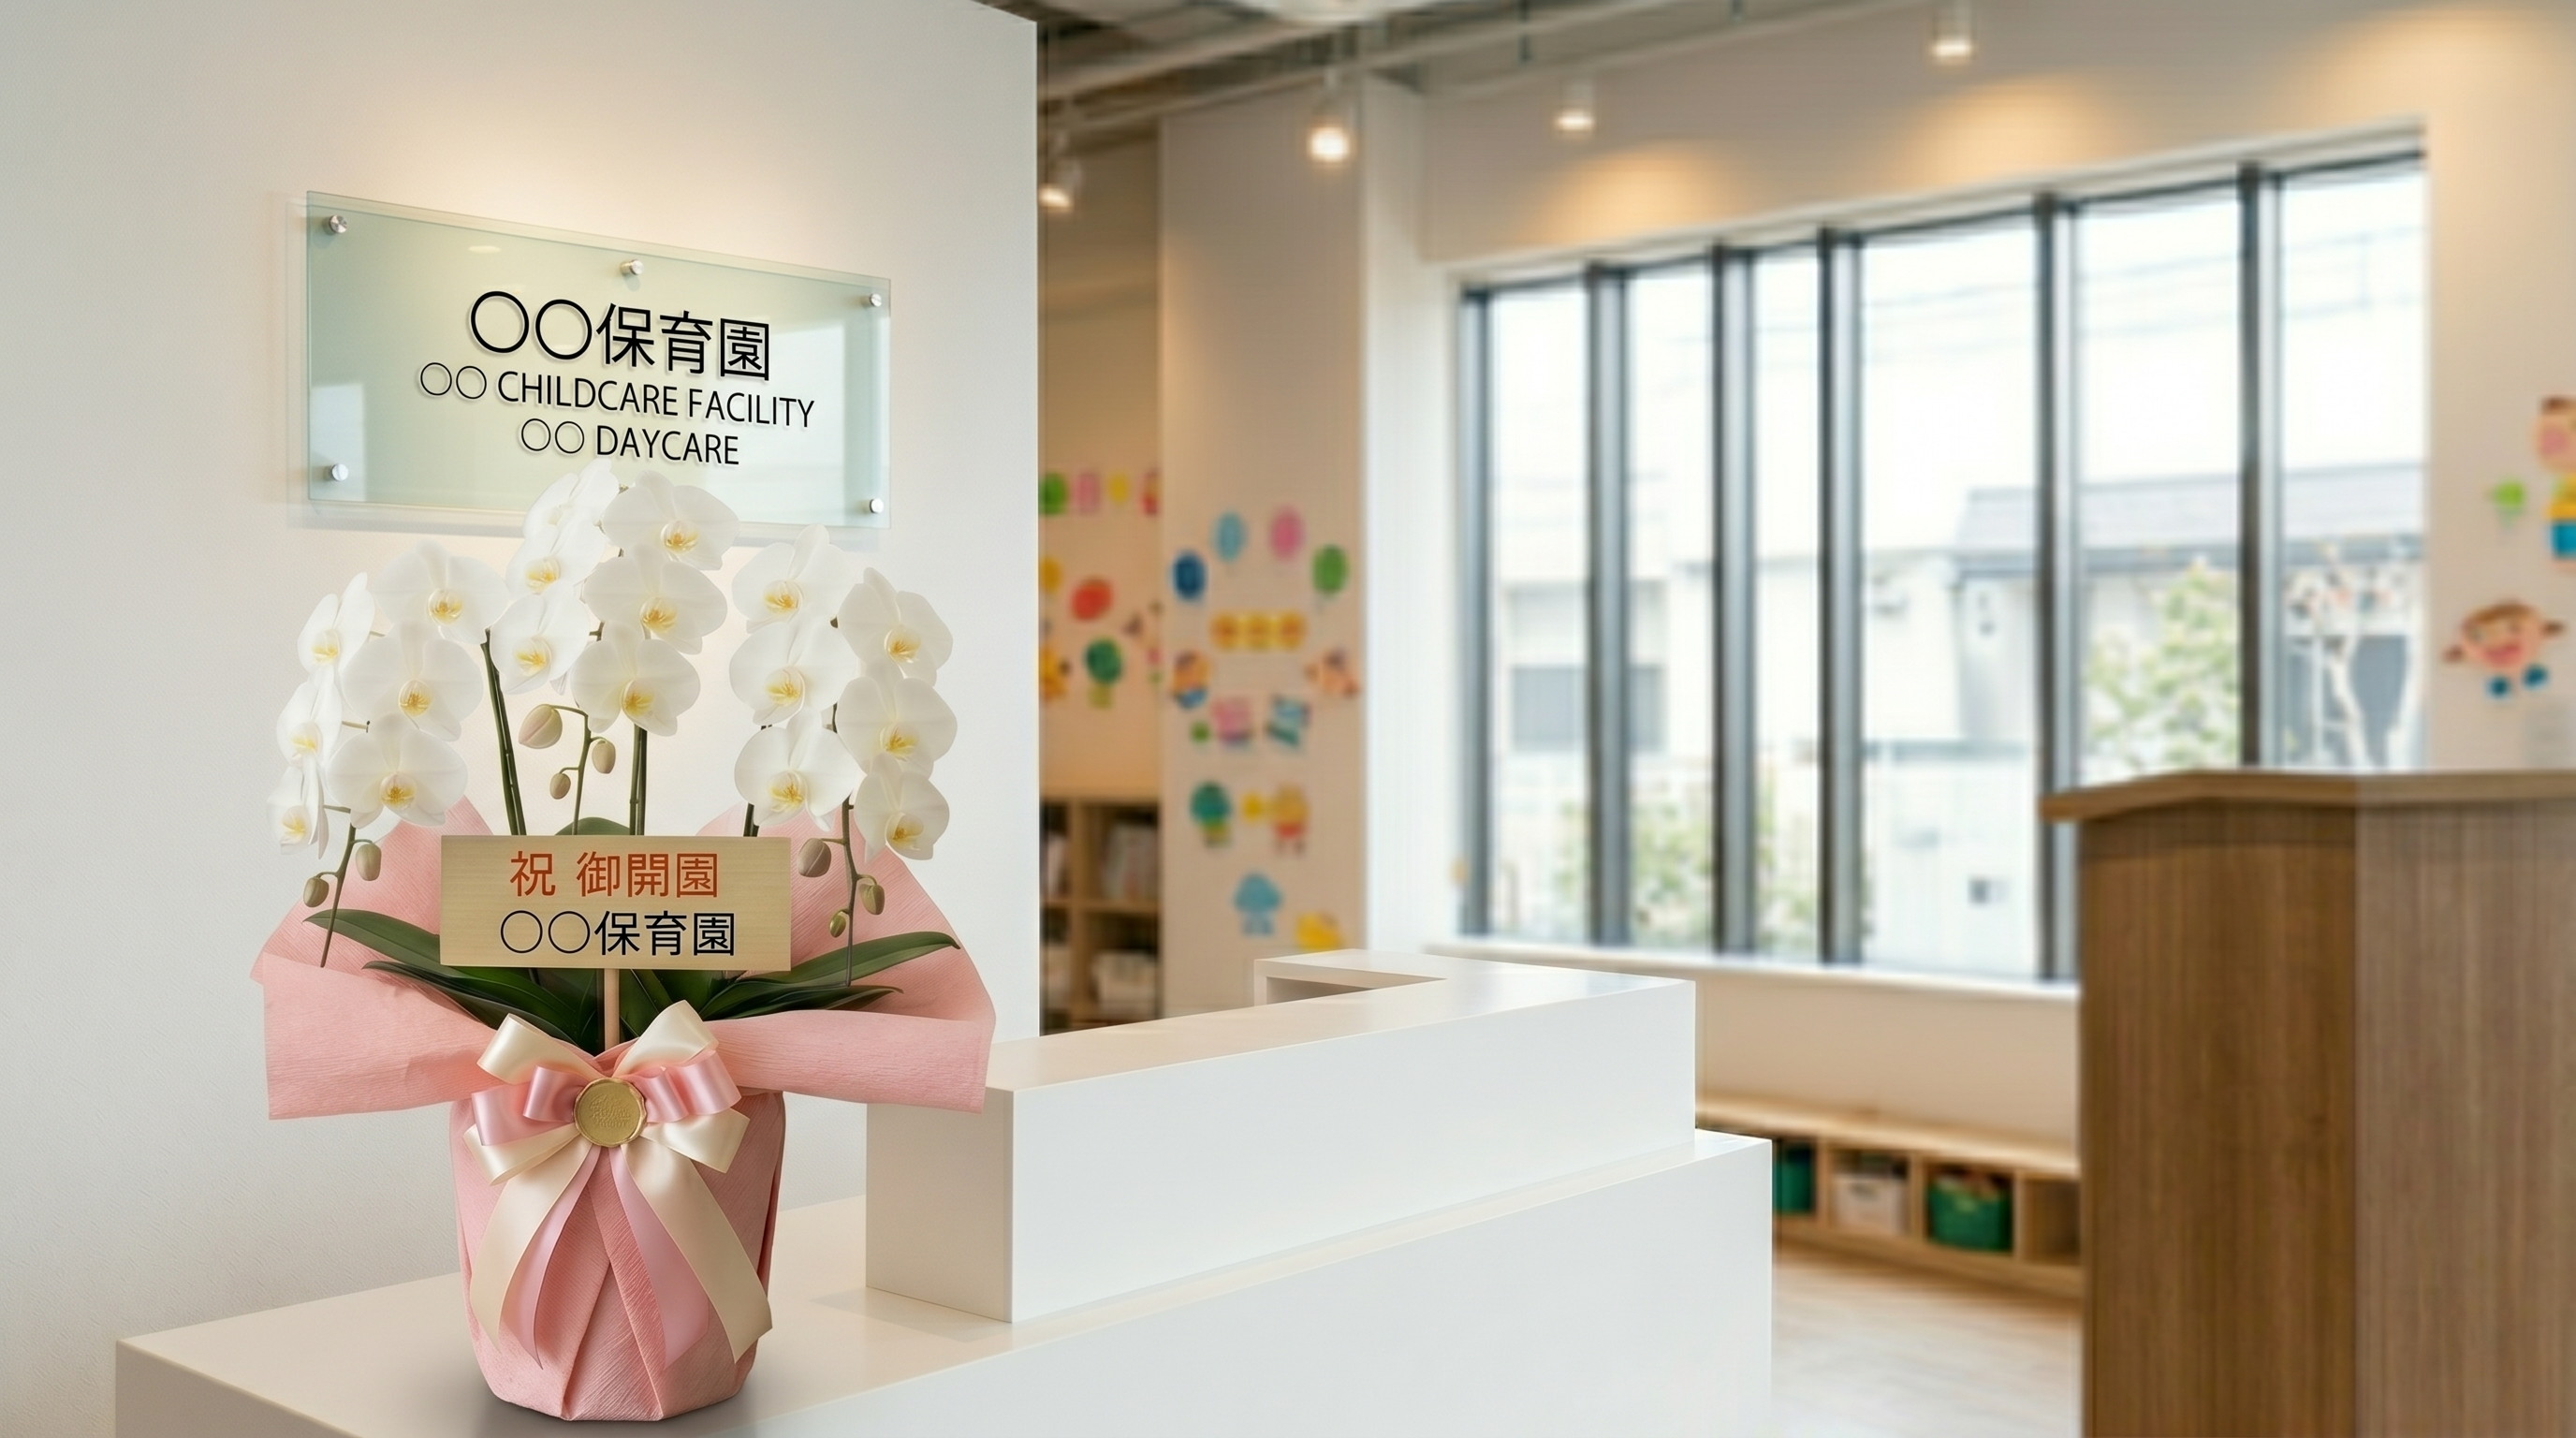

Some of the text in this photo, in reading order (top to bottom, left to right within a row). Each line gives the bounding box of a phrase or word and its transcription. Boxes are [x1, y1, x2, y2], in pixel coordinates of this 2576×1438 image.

[497, 370, 680, 417] CHILDCARE
[688, 387, 816, 429] FACILITY
[596, 424, 739, 465] DAYCARE
[509, 849, 719, 899] 祝 御開園
